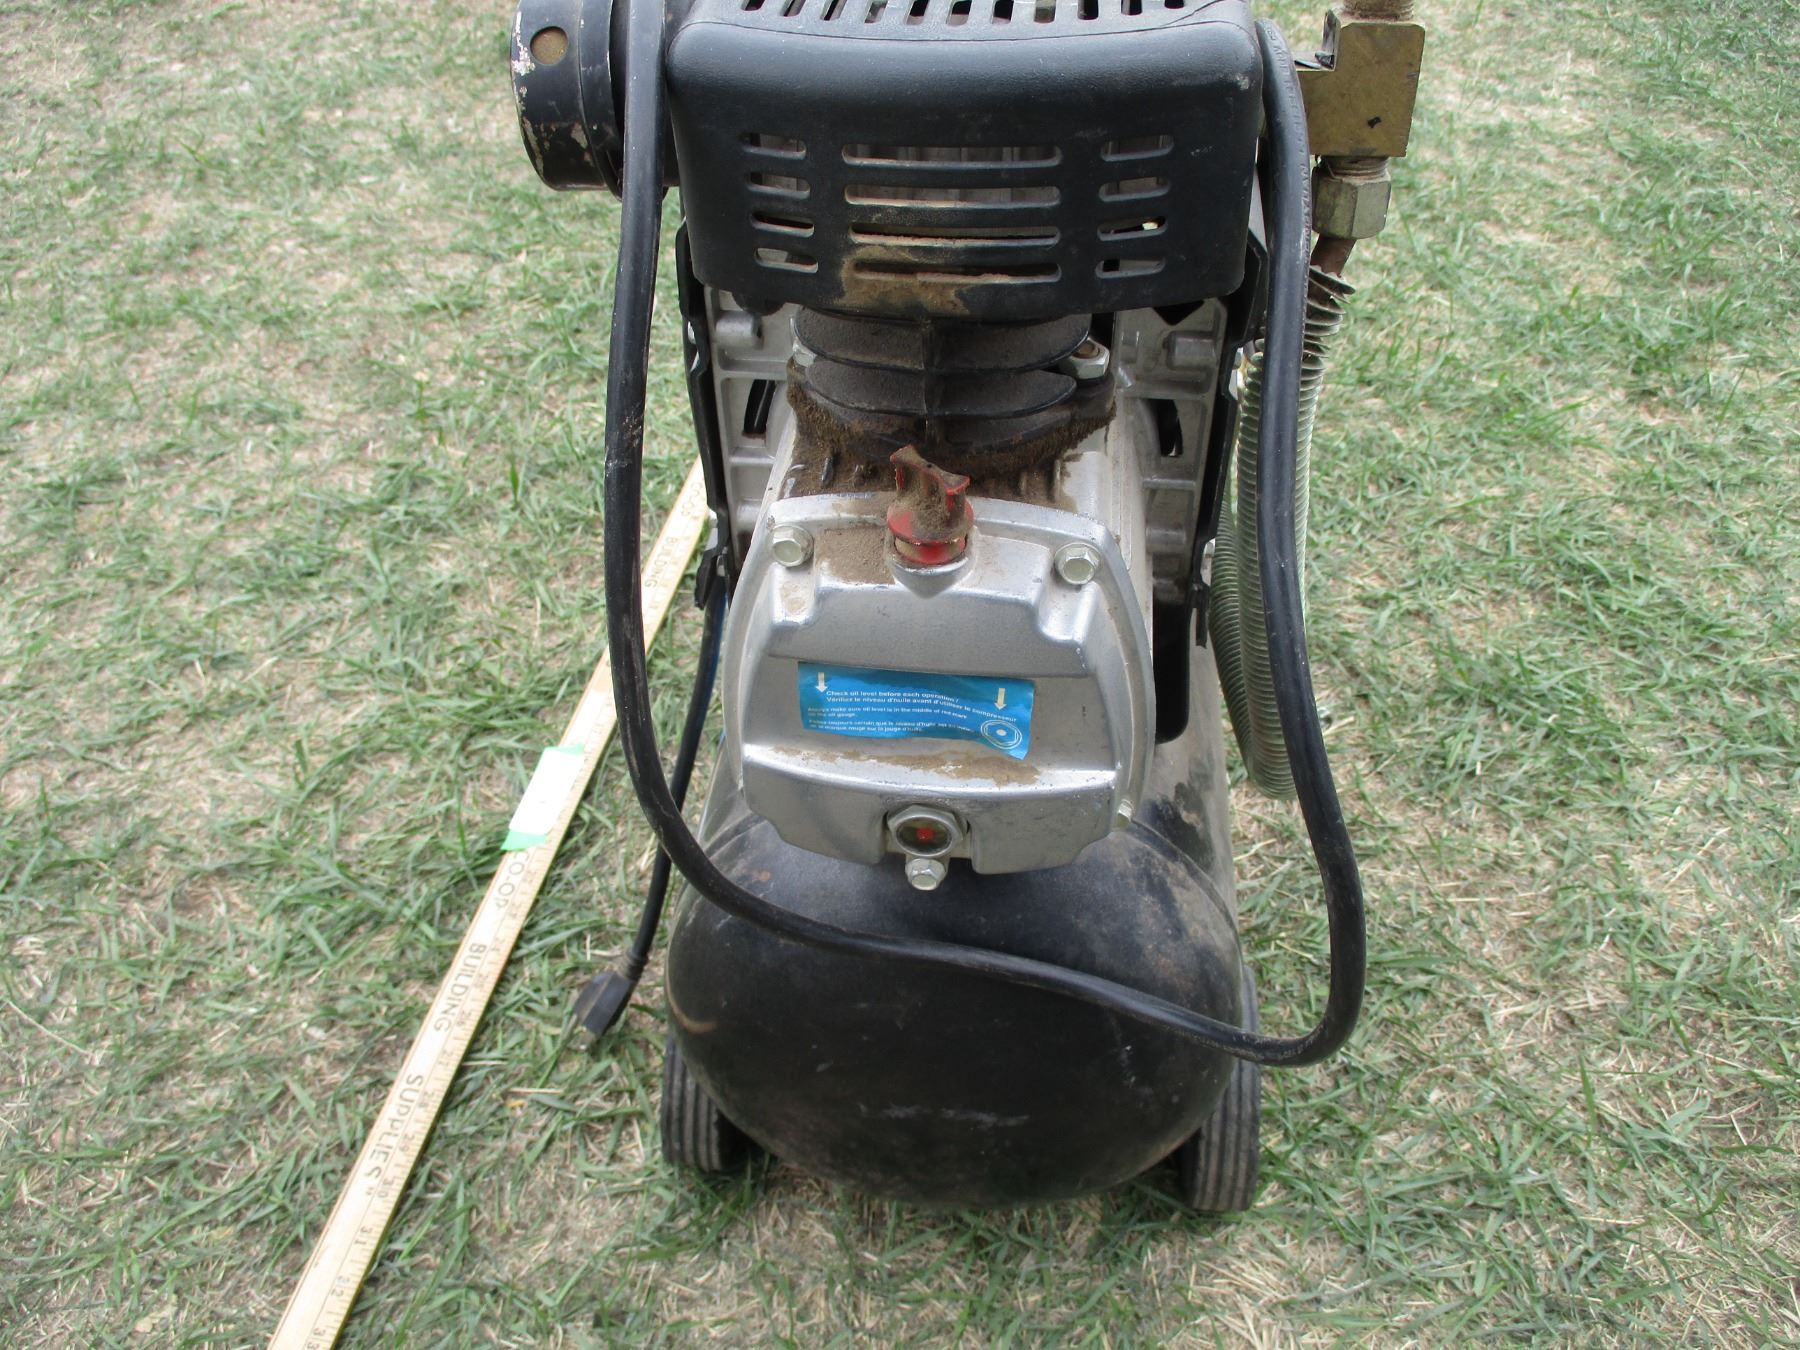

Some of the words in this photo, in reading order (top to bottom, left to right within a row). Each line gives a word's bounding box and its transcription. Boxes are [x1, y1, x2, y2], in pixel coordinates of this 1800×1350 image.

[644, 535, 679, 589] BUILDING
[921, 692, 955, 703] operation
[972, 708, 1017, 723] compresseur
[493, 850, 531, 910] CO-OP
[432, 942, 489, 1033] BUILDING
[398, 1132, 416, 1153] 29
[376, 1177, 395, 1199] 30
[353, 1225, 373, 1246] 31
[330, 1275, 351, 1298] 32
[306, 1327, 327, 1350] 33
